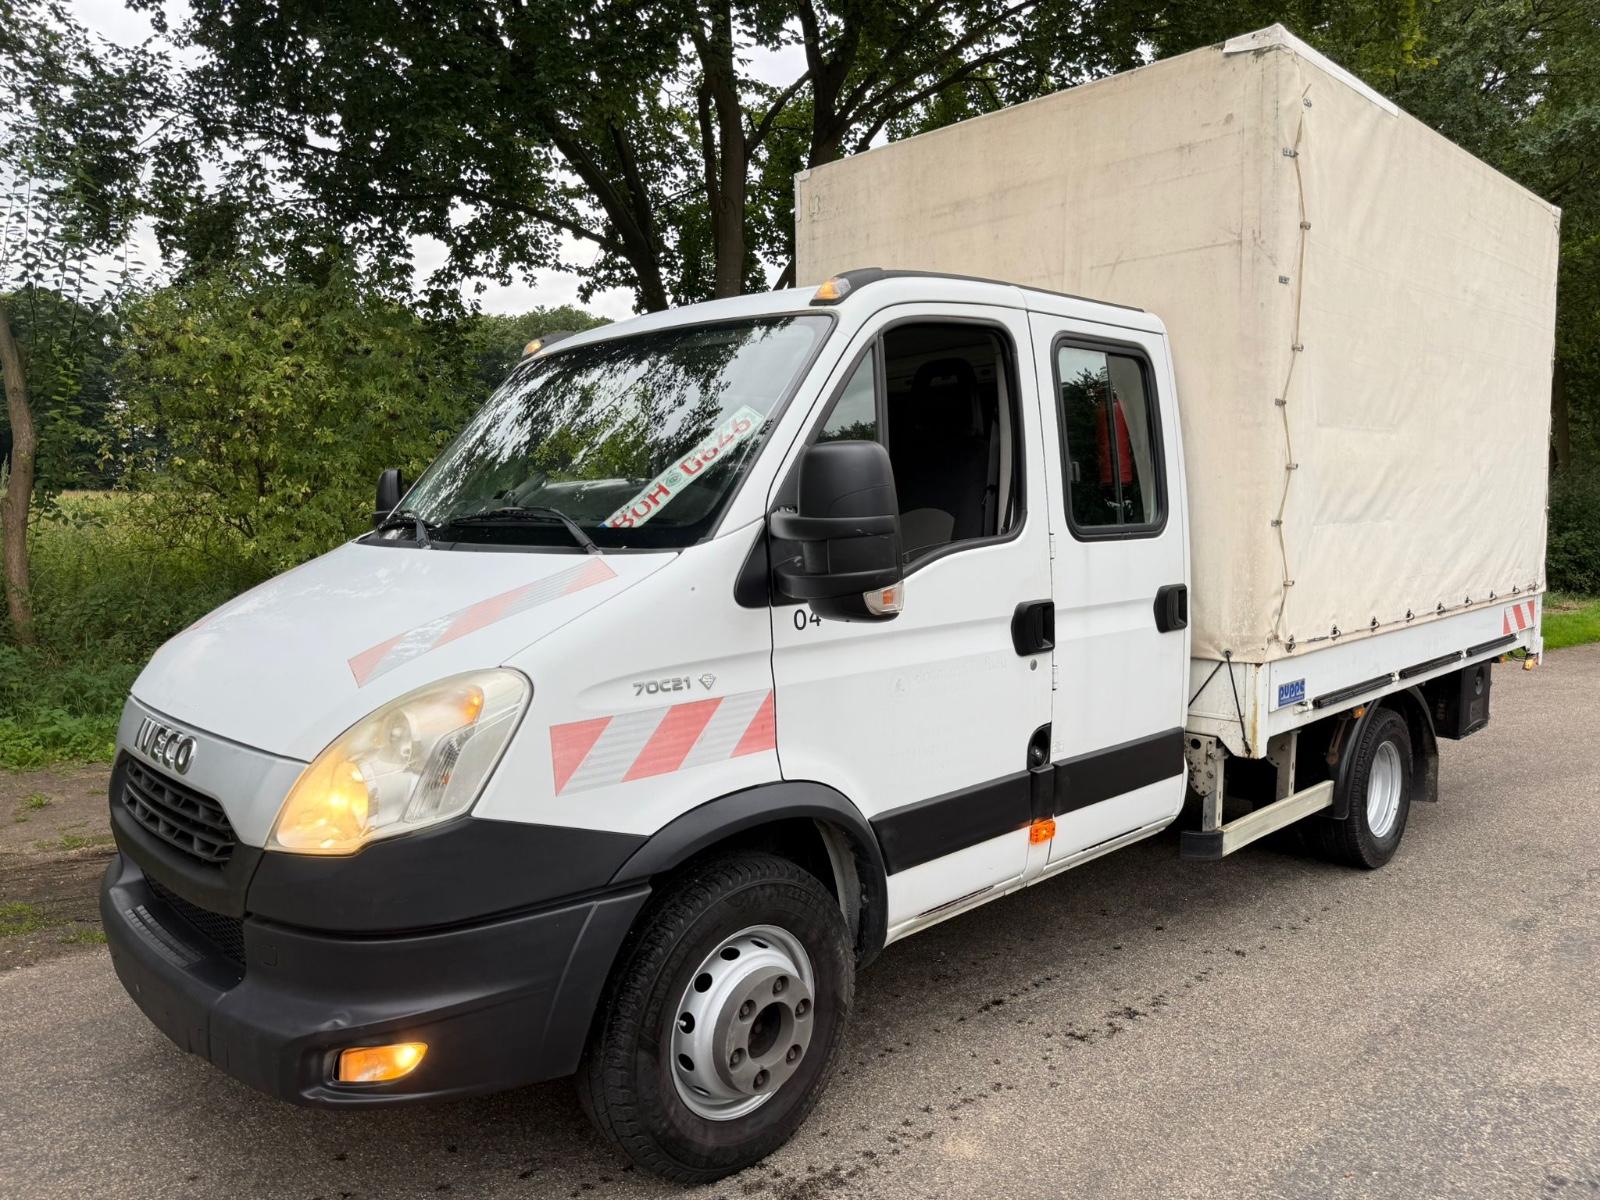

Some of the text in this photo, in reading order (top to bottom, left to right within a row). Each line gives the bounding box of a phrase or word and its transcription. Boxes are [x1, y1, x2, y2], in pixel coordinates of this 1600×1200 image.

[611, 482, 671, 528] BOH
[794, 608, 822, 631] 04
[632, 676, 692, 697] 70C21
[134, 713, 197, 775] IVECO
